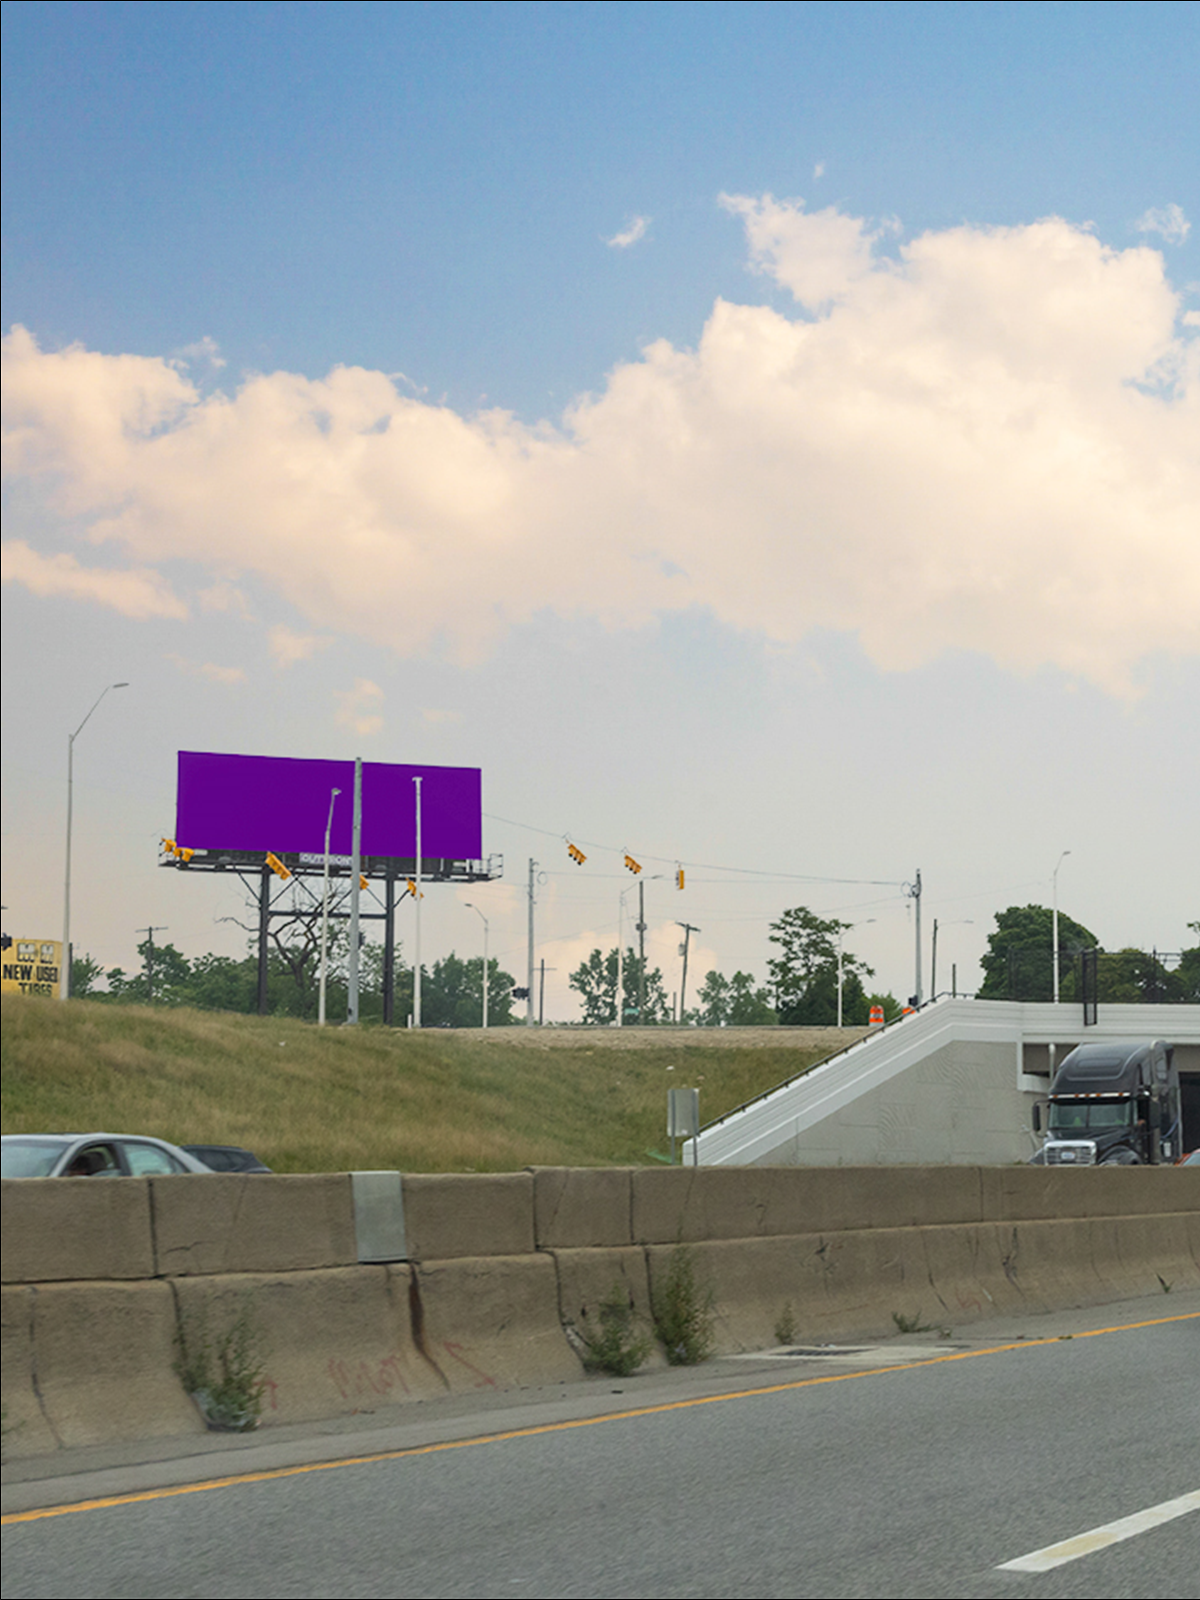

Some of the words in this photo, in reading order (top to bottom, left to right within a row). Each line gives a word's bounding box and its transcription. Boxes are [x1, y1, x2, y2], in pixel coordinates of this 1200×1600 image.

[3, 964, 33, 980] NEW
[36, 966, 58, 983] USED
[18, 982, 52, 997] TIRES
